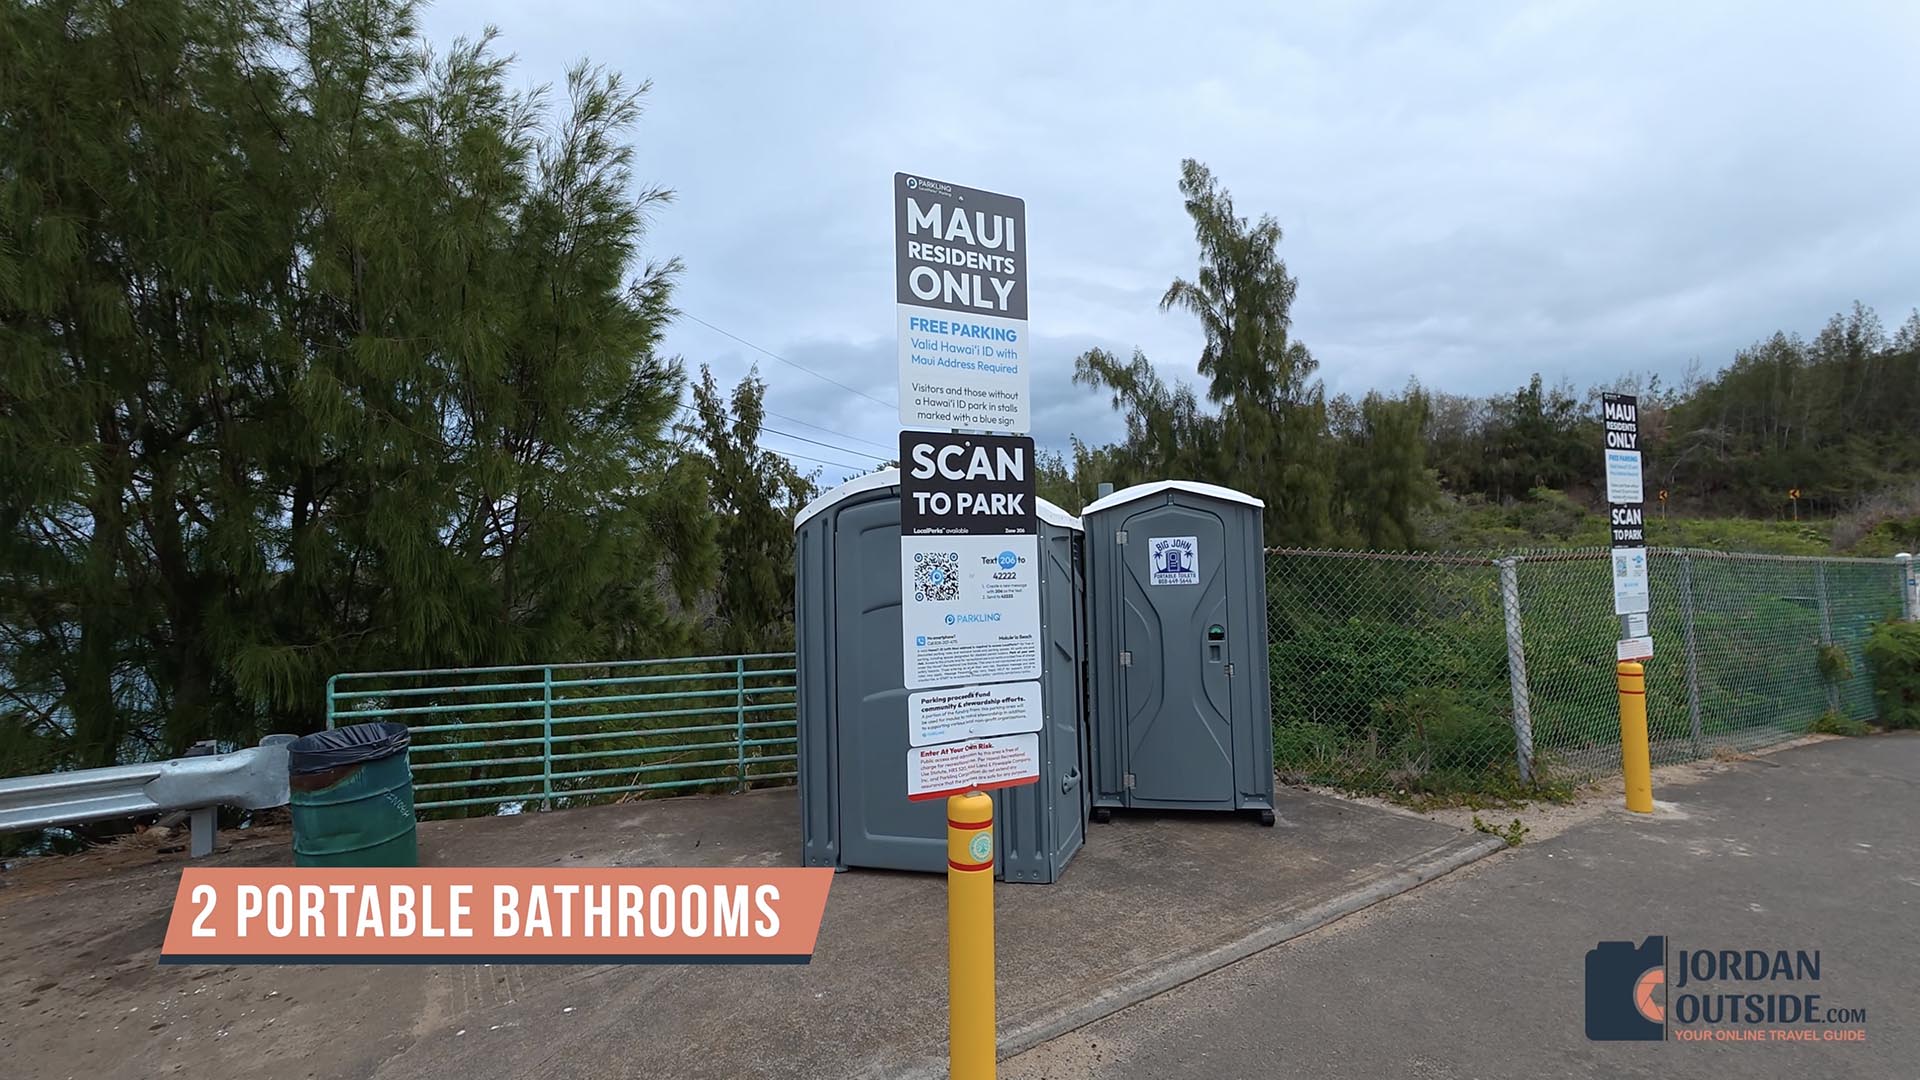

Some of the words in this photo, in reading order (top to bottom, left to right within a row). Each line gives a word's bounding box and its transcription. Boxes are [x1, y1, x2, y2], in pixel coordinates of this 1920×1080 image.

[919, 180, 952, 192] PARKLINQ
[907, 197, 1015, 252] MAUI
[908, 241, 1015, 274] RESIDENTS
[909, 266, 1016, 311] ONLY
[910, 317, 948, 334] FREE
[951, 322, 1017, 342] PARKING
[910, 338, 938, 351] Valid
[982, 346, 994, 356] ID
[996, 348, 1018, 360] with
[912, 354, 936, 366] Maui
[937, 358, 976, 370] Address
[977, 361, 1018, 374] Required
[912, 382, 944, 394] Visitors
[946, 387, 962, 395] and
[964, 388, 987, 398] those
[988, 390, 1018, 400] without
[956, 400, 966, 408] ID
[968, 401, 987, 411] park
[989, 402, 996, 410] in
[998, 403, 1018, 412] stalls
[1605, 402, 1636, 422] MAUI
[917, 411, 950, 421] marked
[952, 413, 970, 422] with
[980, 414, 997, 424] blue
[998, 416, 1014, 426] sign
[1607, 431, 1637, 448] ONLY
[910, 444, 1024, 481] SCAN
[912, 492, 952, 516] TO
[957, 493, 1025, 516] PARK
[1612, 508, 1642, 525] SCAN
[1613, 529, 1624, 540] TO
[1624, 529, 1642, 540] PARK
[1156, 540, 1170, 551] BIG
[1171, 539, 1192, 550] JOHN
[981, 556, 998, 564] Text
[1000, 556, 1016, 564] 206
[992, 572, 1016, 580] 42222
[956, 612, 1001, 623] PARKLINQ
[921, 704, 956, 712] community
[963, 698, 1000, 707] stewardship
[948, 692, 974, 702] proceeds
